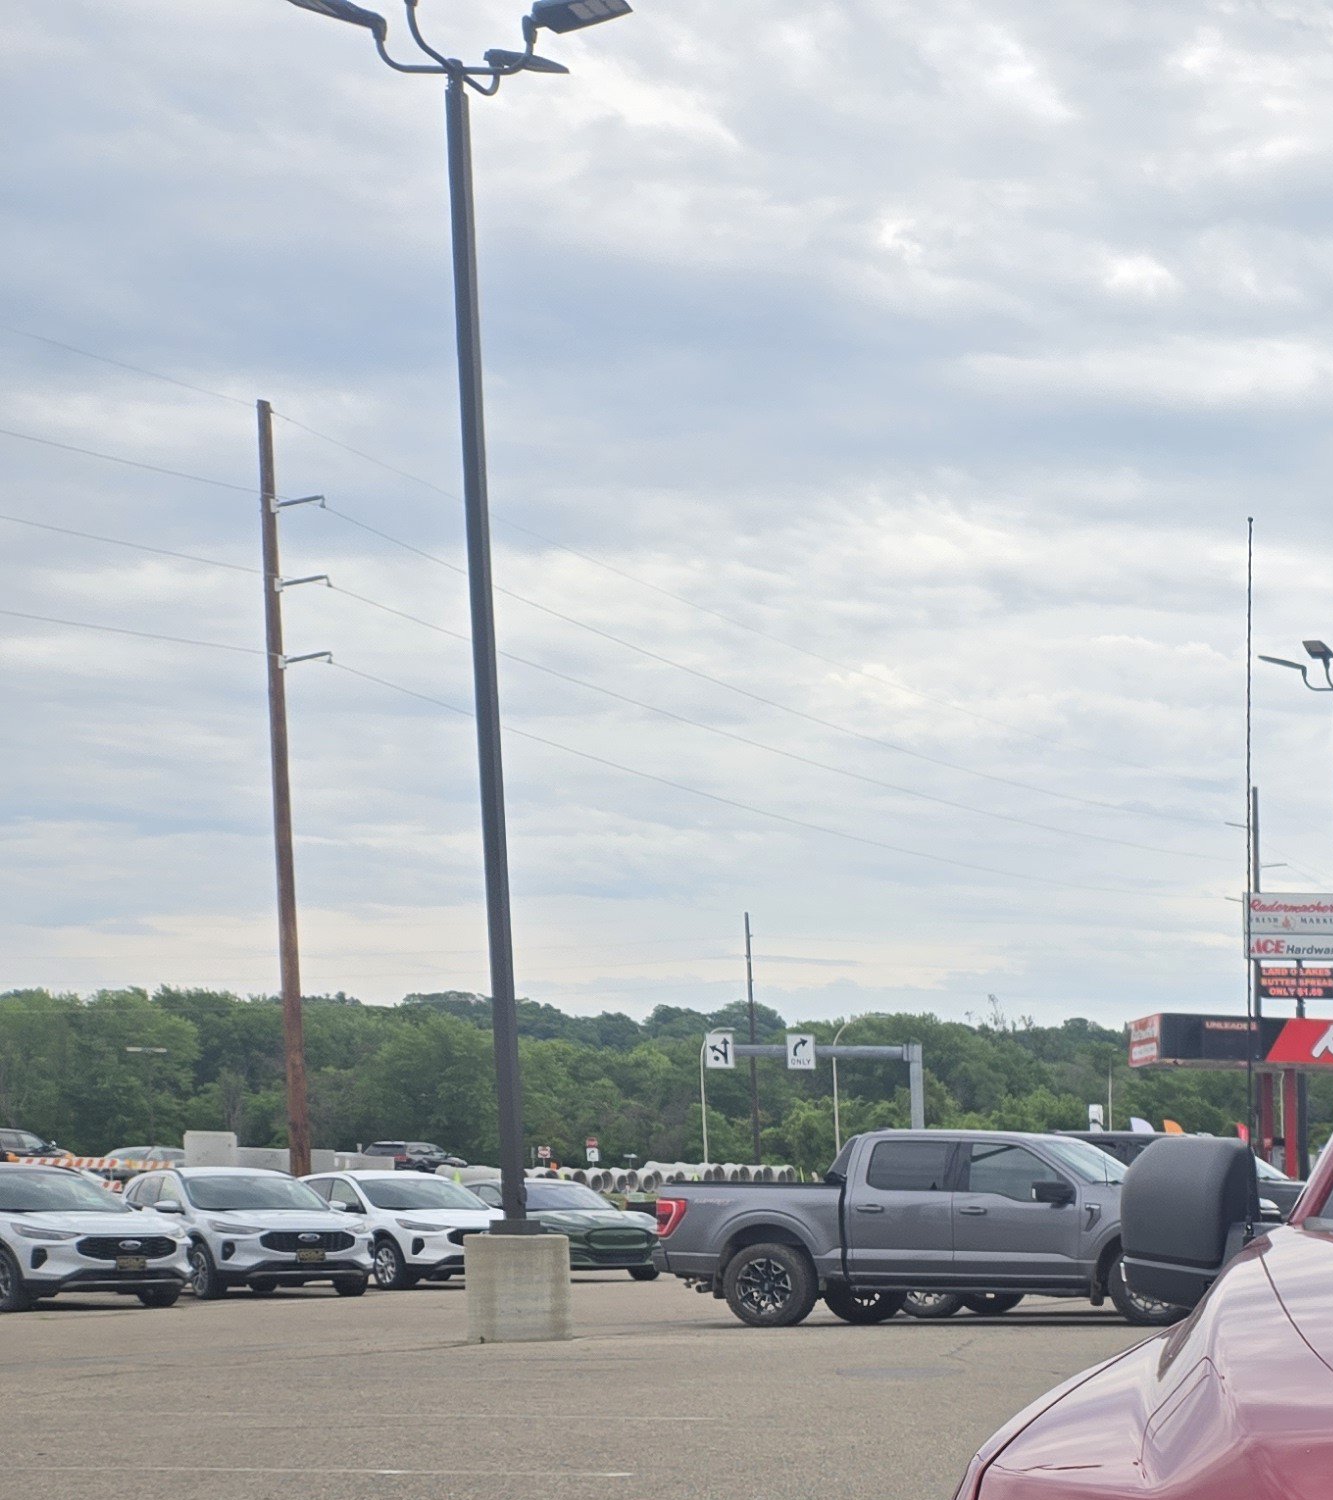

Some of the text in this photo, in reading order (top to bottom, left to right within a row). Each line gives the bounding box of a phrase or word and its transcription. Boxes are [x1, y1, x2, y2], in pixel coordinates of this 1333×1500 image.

[1248, 939, 1286, 955] ACE
[1261, 978, 1297, 987] BUTTER
[1269, 987, 1295, 996] ONLY
